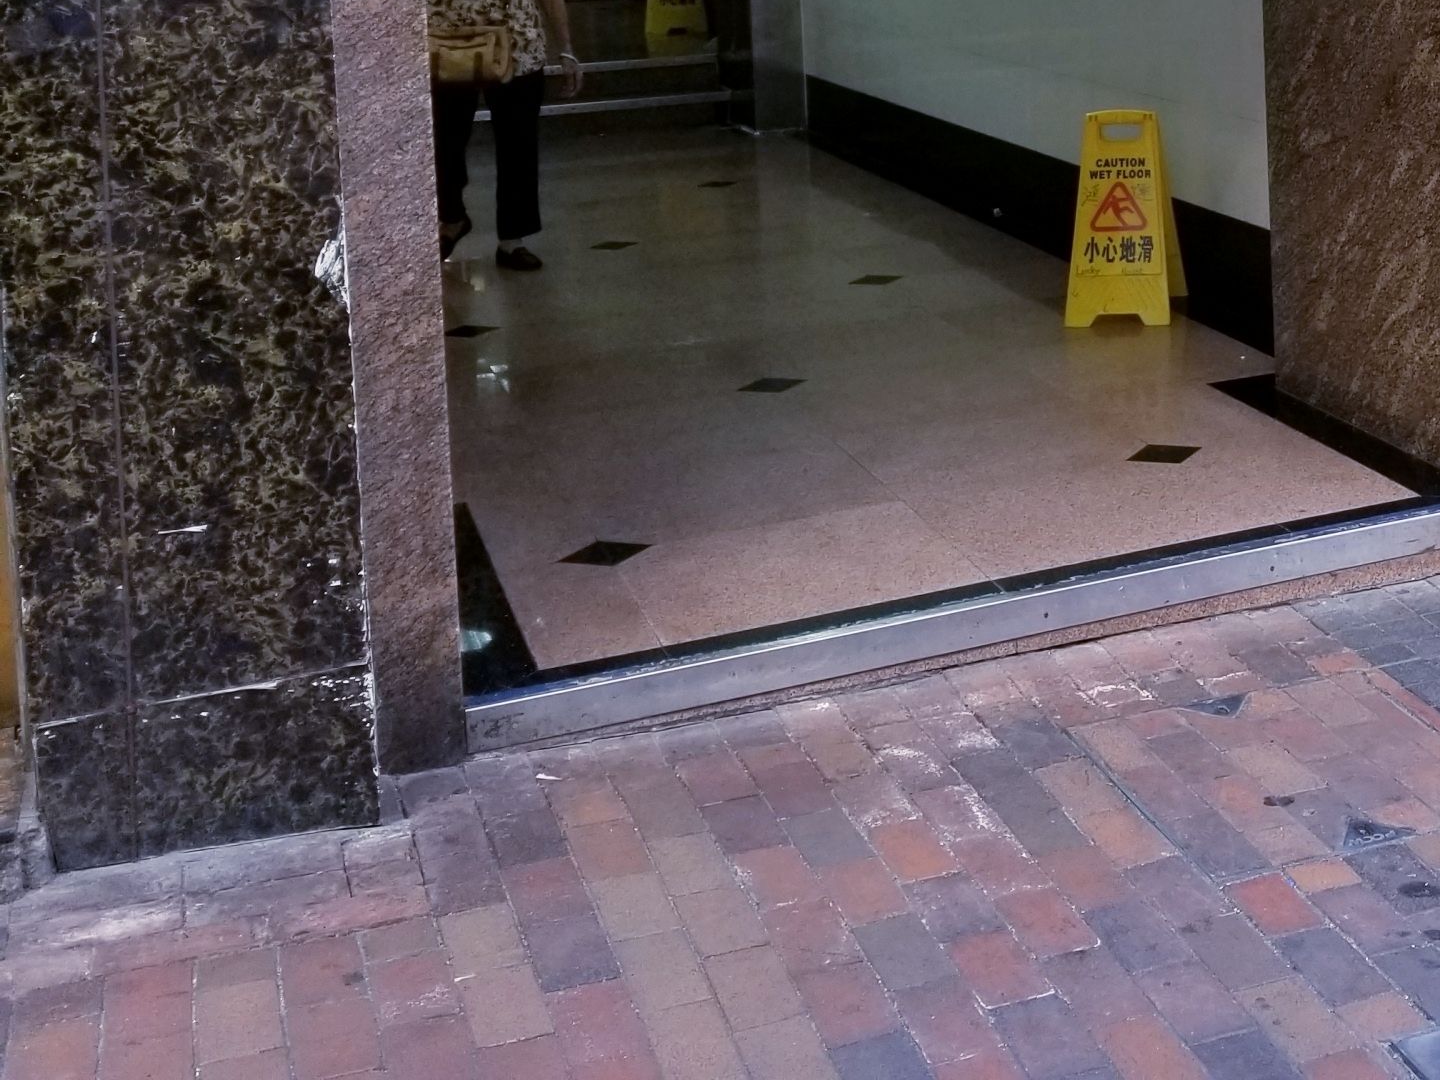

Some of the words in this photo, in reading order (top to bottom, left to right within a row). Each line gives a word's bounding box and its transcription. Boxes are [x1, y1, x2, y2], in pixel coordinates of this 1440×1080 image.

[1095, 158, 1146, 168] CAUTION
[1089, 170, 1112, 180] WET
[1116, 169, 1152, 179] FLOOR
[1083, 236, 1154, 263] 小心地滑
